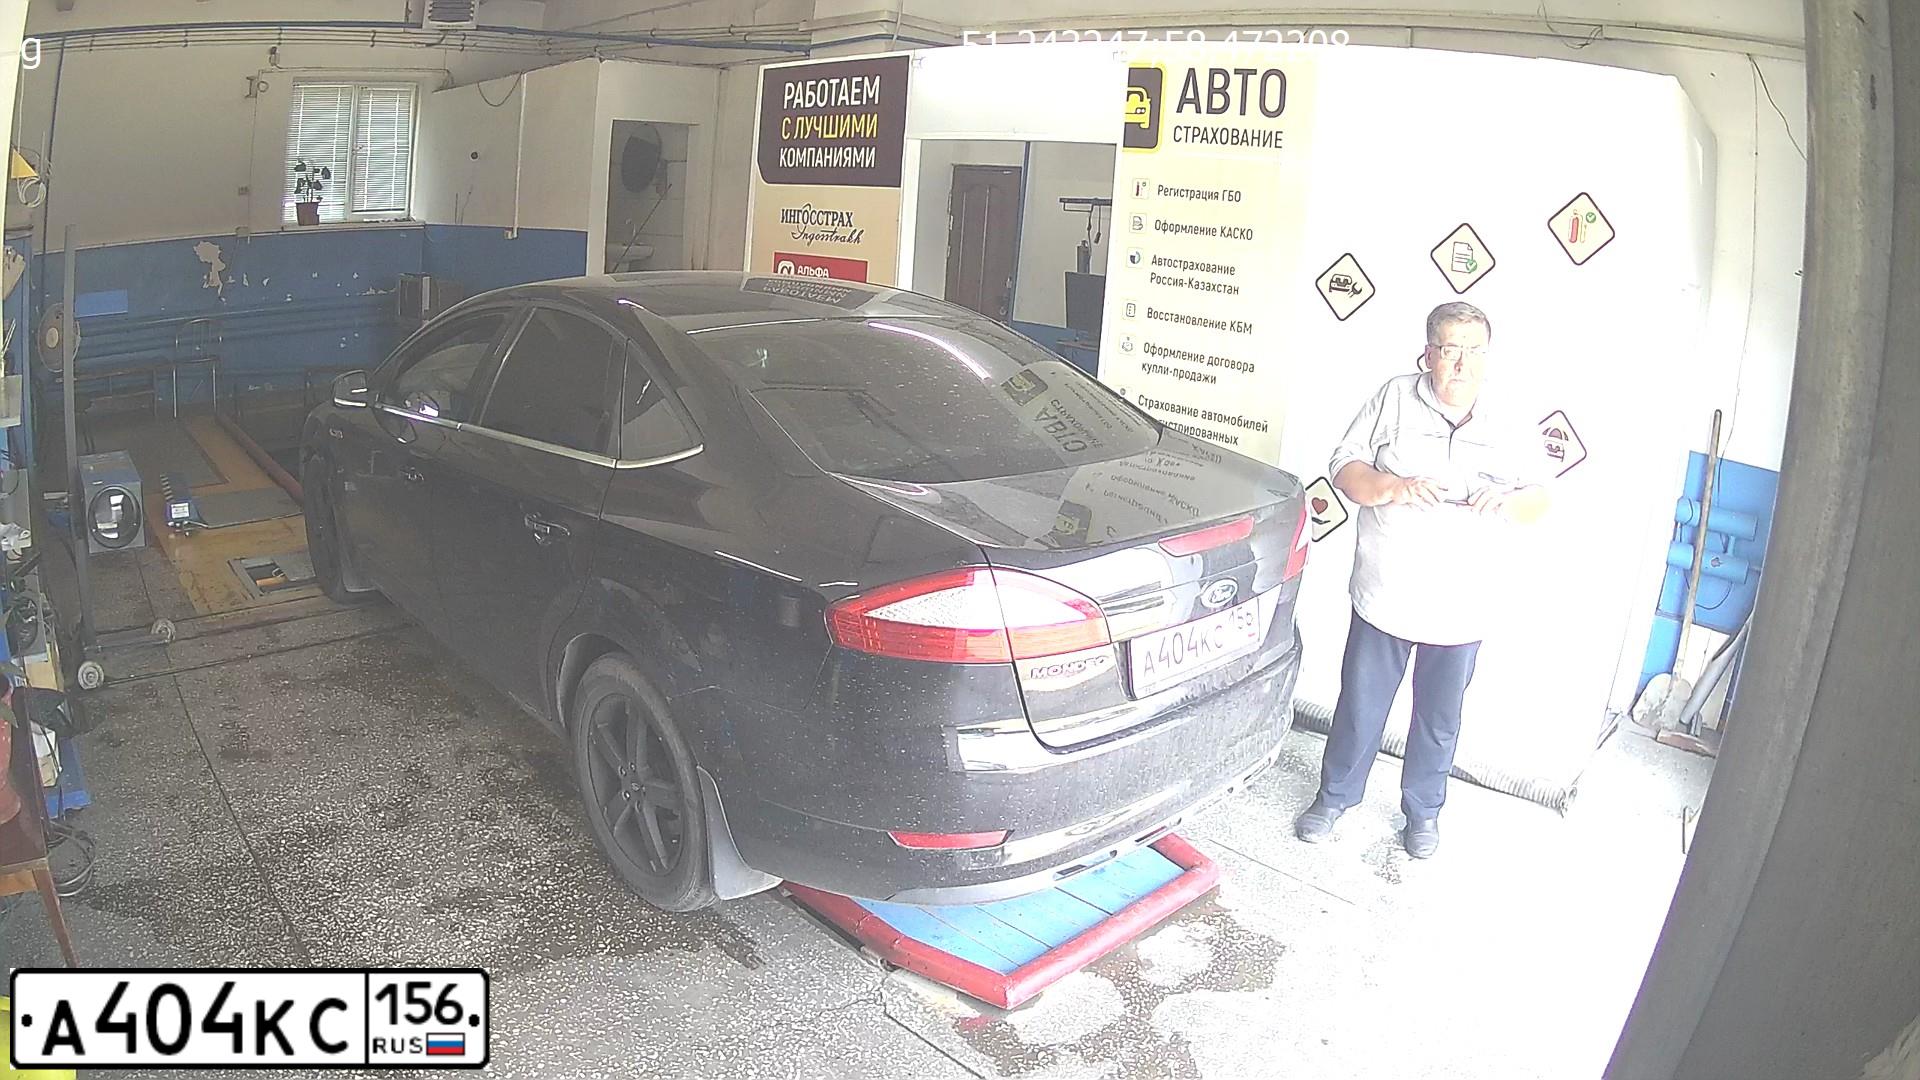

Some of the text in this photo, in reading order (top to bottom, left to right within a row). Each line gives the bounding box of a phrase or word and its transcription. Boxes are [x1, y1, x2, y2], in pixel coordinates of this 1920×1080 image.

[783, 75, 881, 109] РАБОТАЕМ
[1175, 67, 1287, 119] АВТО
[781, 113, 878, 140] С ЛУЧШИМИ
[1173, 125, 1283, 149] СТРАХОВАНИЕ
[779, 146, 876, 169] КОМПАНИЯМИ
[1157, 184, 1242, 203] Регистрация ГБО
[780, 203, 853, 228] ИНГОССТРАХ
[1154, 219, 1253, 241] Оформление КАСКО
[797, 265, 830, 279] АЛЬФА
[1151, 254, 1236, 276] Автострахование
[1150, 272, 1240, 295] Россия-Казахстан
[1147, 307, 1253, 335] Восстановление КБМ
[1143, 342, 1255, 374] Оформление договора
[1141, 362, 1217, 385] купли-продажи
[1138, 394, 1199, 418] Страхование
[1201, 409, 1268, 433] автомобилей
